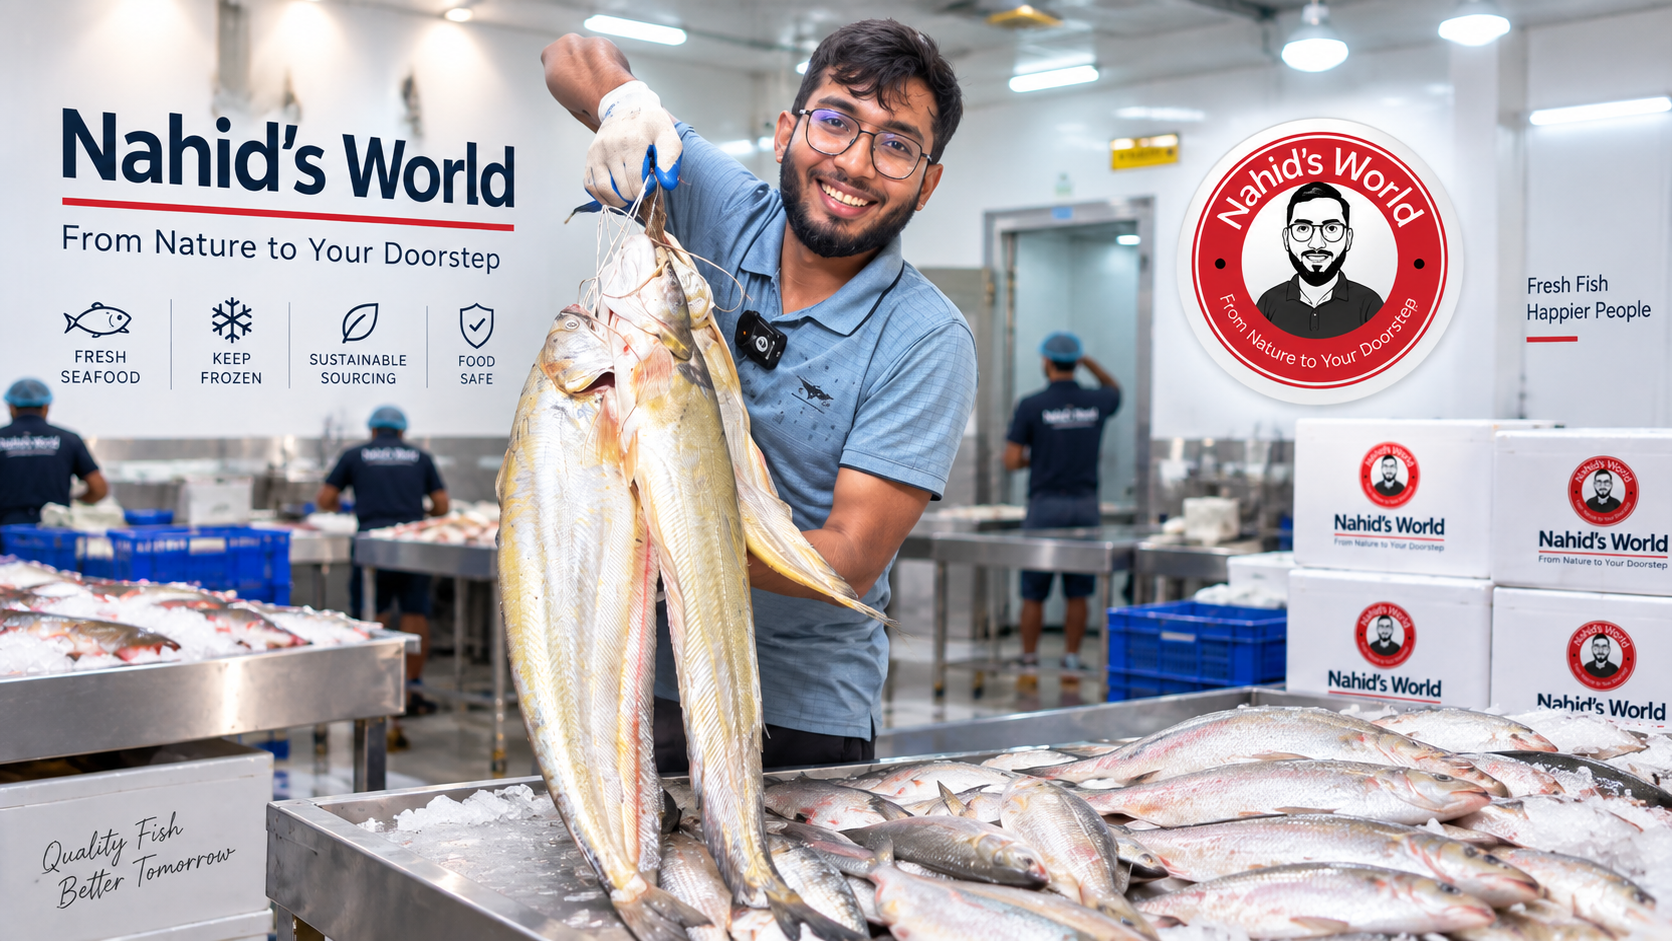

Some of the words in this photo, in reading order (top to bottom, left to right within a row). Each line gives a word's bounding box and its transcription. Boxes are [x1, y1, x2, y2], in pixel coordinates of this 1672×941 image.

[62, 107, 326, 196] Nahid's
[342, 133, 515, 208] World
[1216, 147, 1324, 231] Nahid's
[1334, 146, 1425, 229] World
[63, 224, 142, 253] From
[155, 229, 257, 259] Nature
[267, 237, 297, 261] to
[308, 237, 374, 264] Your
[384, 241, 500, 275] Doorstep
[1527, 275, 1571, 295] Fresh
[1576, 273, 1608, 293] Fish
[1527, 302, 1591, 325] Happier
[1595, 299, 1652, 323] People
[1219, 293, 1247, 333] From
[1246, 328, 1296, 365] Nature
[1300, 352, 1317, 369] to
[1320, 350, 1358, 368] Your
[1358, 297, 1418, 357] Doorstep
[75, 349, 126, 364] FRESH
[213, 352, 251, 365] KEEP
[309, 353, 407, 367] SUSTAINABLE
[458, 355, 496, 368] FOOD
[60, 369, 141, 384] SEAFOOD
[201, 371, 262, 385] FROZEN
[321, 371, 396, 385] SOURCING
[460, 372, 493, 385] SAFE
[1335, 514, 1392, 532] Nahid's
[1396, 517, 1444, 535] World
[1334, 538, 1353, 546] From
[1389, 542, 1407, 550] Your
[1408, 543, 1445, 553] Doorstep
[1539, 531, 1606, 549] Nahid's
[1611, 533, 1668, 552] World
[1538, 555, 1561, 563] From
[1563, 557, 1592, 566] Nature
[1594, 558, 1603, 566] to
[1605, 559, 1625, 568] Your
[1627, 560, 1668, 570] Doorstep
[1329, 670, 1387, 692] Nahid's
[1391, 676, 1441, 697] World
[1537, 693, 1605, 714] Nahid's
[1609, 699, 1665, 721] World
[41, 828, 128, 875] Quality
[135, 811, 184, 850] Fish
[56, 869, 125, 909] Better
[132, 847, 236, 888] Tomorrow
